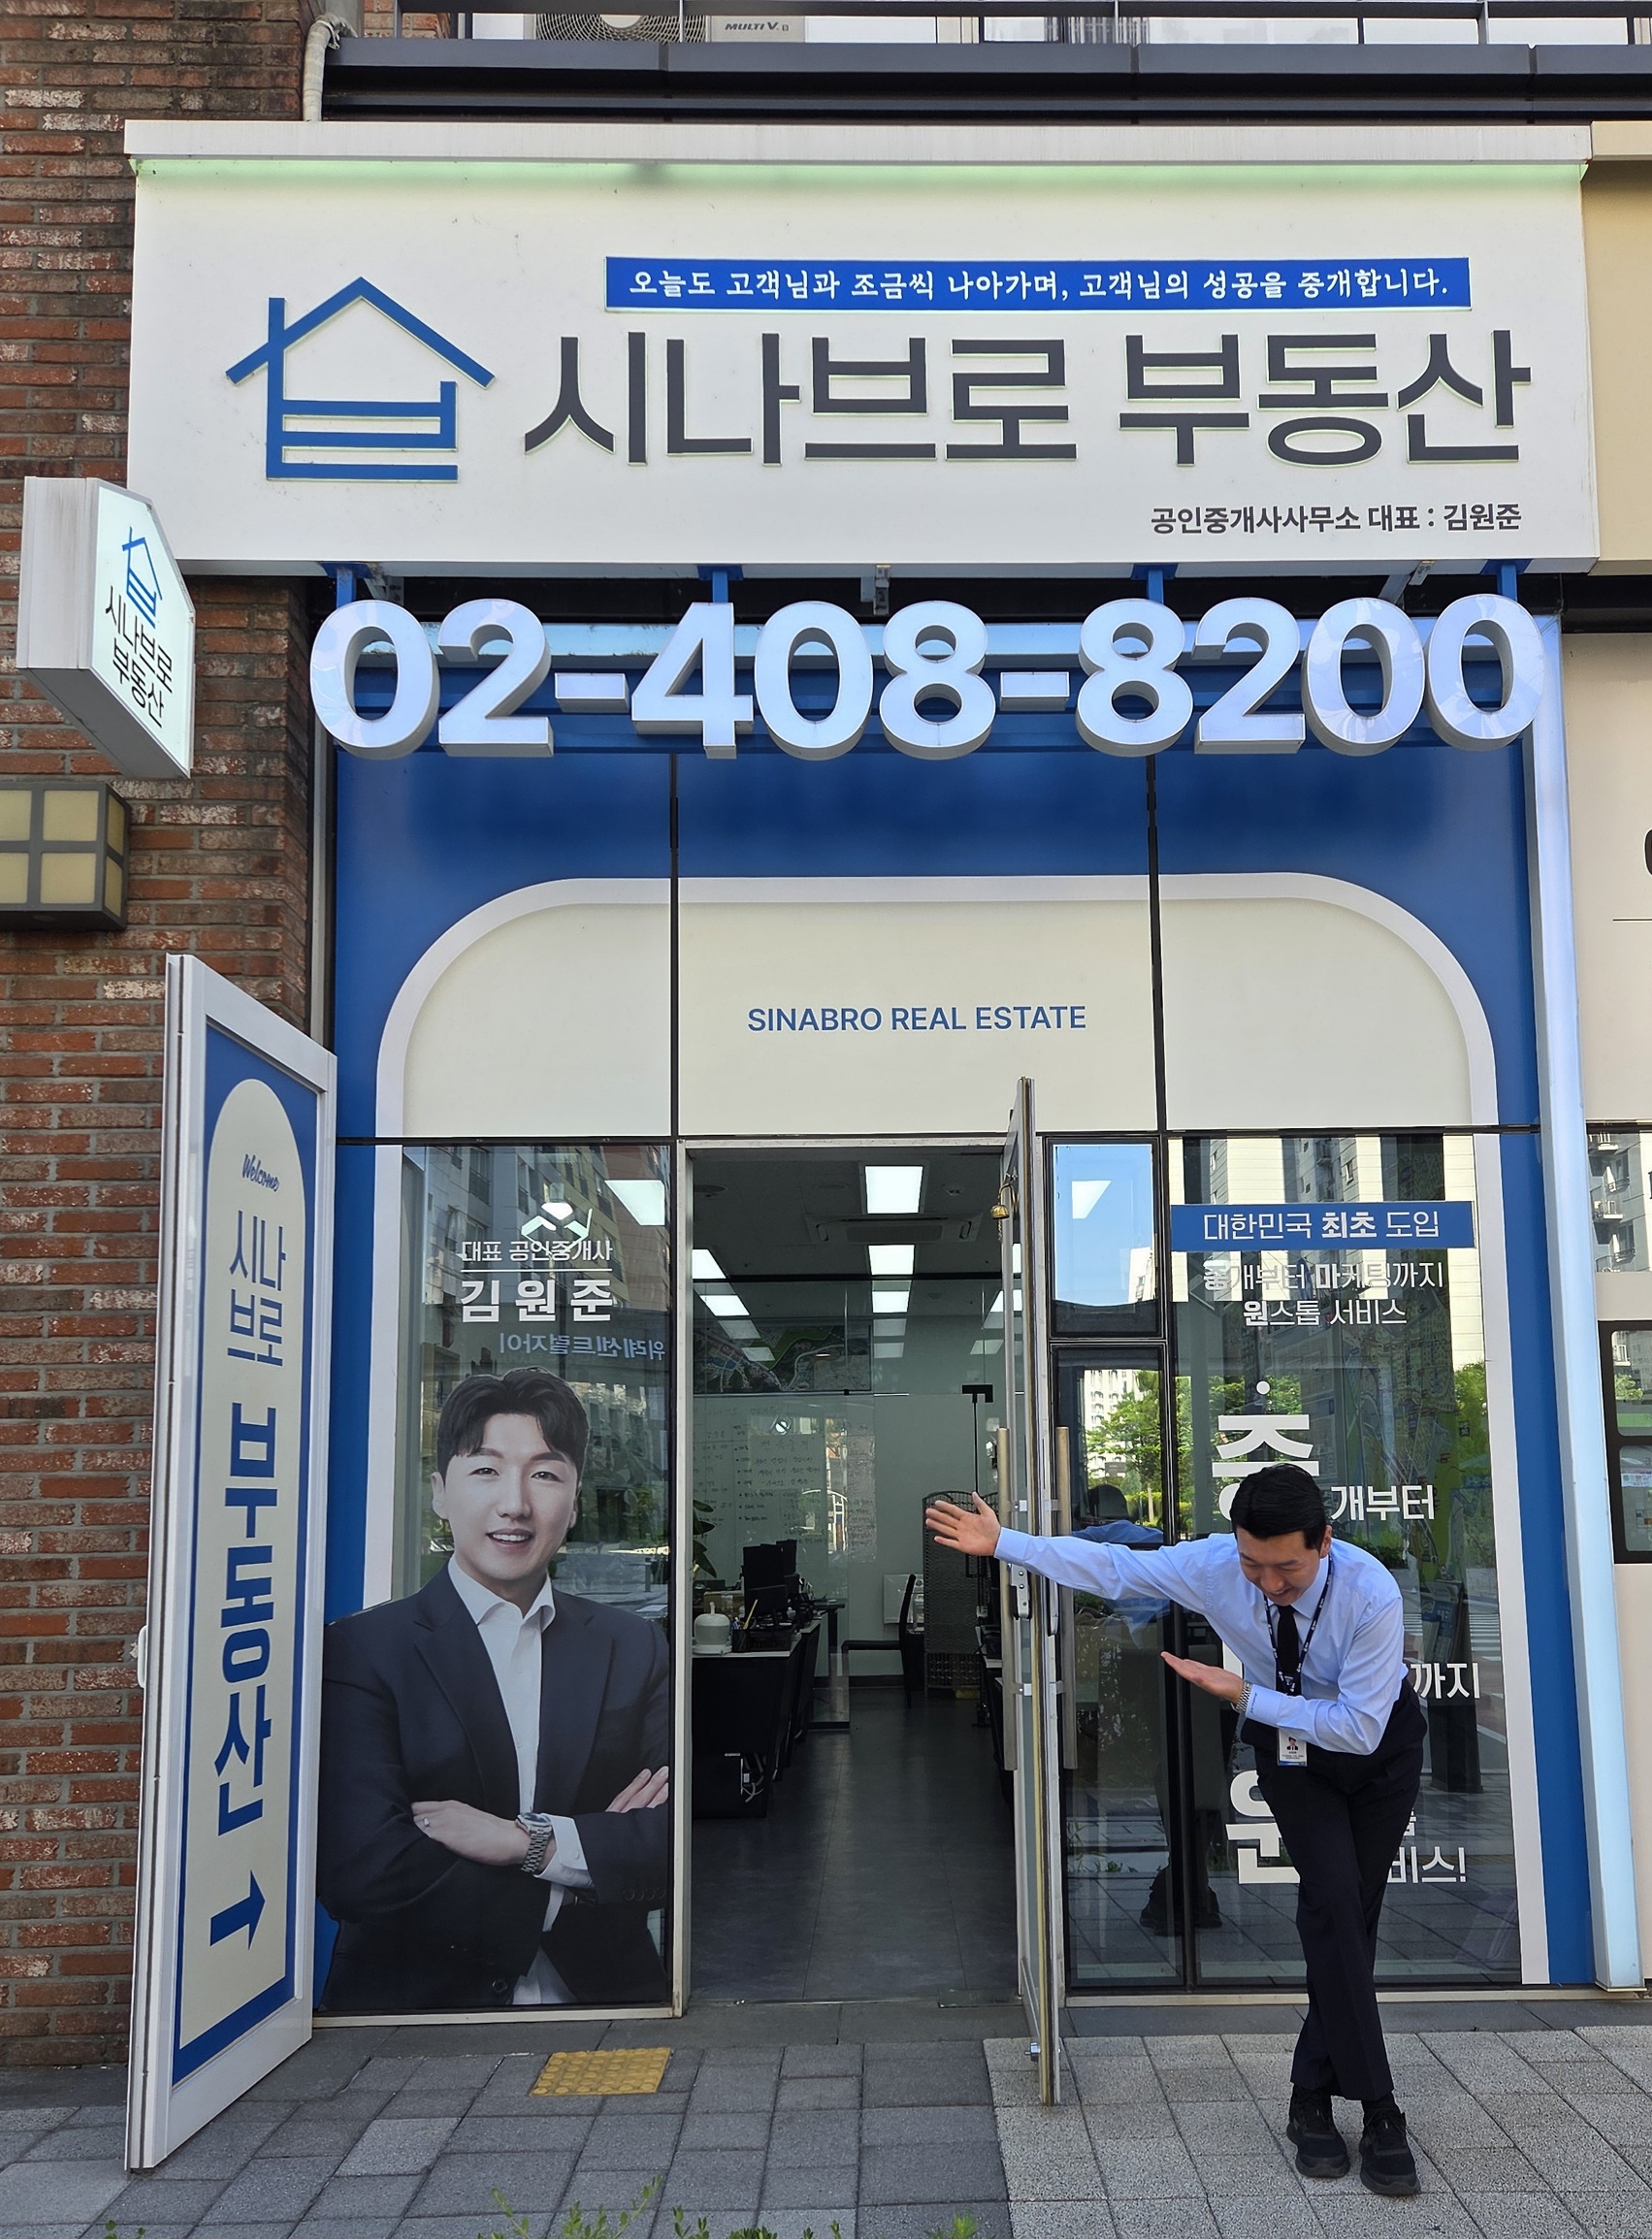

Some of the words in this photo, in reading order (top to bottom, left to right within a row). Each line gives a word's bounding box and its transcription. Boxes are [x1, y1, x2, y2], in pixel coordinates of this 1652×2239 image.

[724, 22, 765, 31] MULTI
[629, 270, 717, 299] 오늘도
[725, 270, 841, 301] 고객님과
[851, 270, 935, 301] 조금씩
[947, 270, 1069, 302] 나아가며,
[1078, 269, 1189, 301] 고객님의
[1202, 269, 1287, 300] 성공을
[1297, 267, 1449, 299] 중개합니다.
[524, 331, 1077, 466] 시나브로
[1119, 330, 1531, 467] 부동산
[1150, 503, 1361, 534] 공인중개사사무소
[1367, 503, 1421, 532] 대표
[1441, 503, 1522, 532] 김원준
[105, 585, 173, 694] 시나브로
[112, 636, 165, 730] 부동산
[309, 593, 1544, 762] 02-408-8200
[747, 1007, 882, 1031] SINABRO
[891, 1006, 967, 1031] REAL
[975, 1005, 1086, 1030] ESTATE
[242, 1152, 280, 1194] Welcome
[1203, 1212, 1312, 1241] 대한민국
[1321, 1211, 1377, 1239] 최초
[1385, 1210, 1440, 1239] 도입
[461, 1240, 502, 1262] 대표
[508, 1239, 614, 1262] 공인중개사
[1314, 1261, 1444, 1290] 마케팅까지
[1243, 1299, 1321, 1327] 원스톱
[1329, 1298, 1408, 1326] 서비스
[213, 1402, 278, 1836] 부동산
